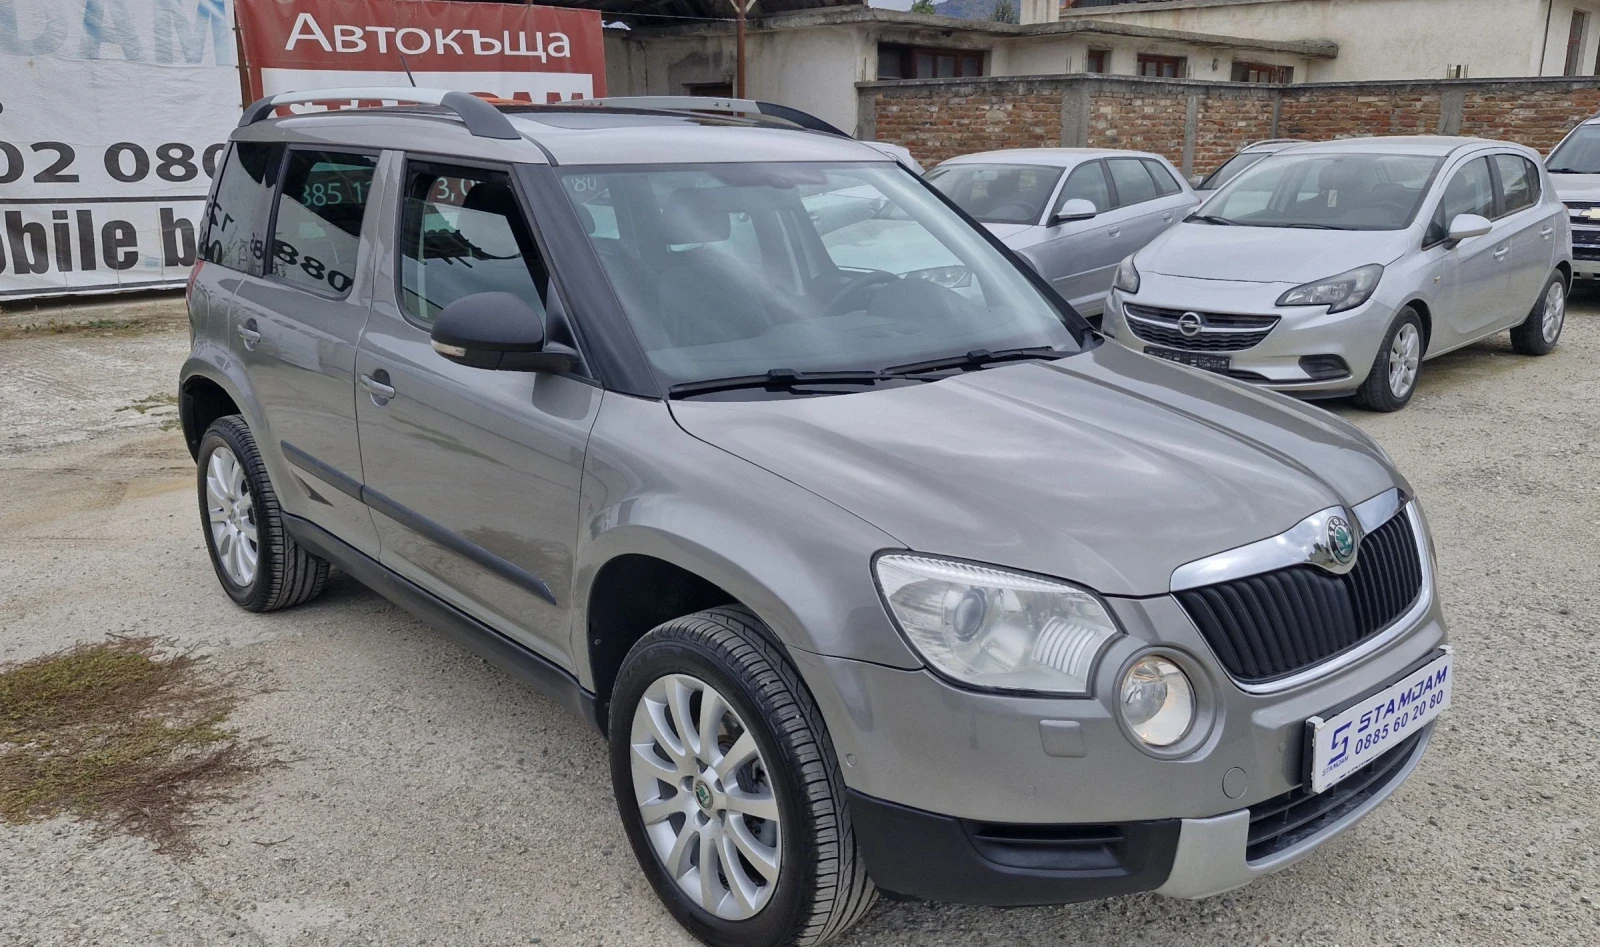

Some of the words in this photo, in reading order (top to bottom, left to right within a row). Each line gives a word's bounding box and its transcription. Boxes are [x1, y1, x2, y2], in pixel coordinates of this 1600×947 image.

[285, 12, 571, 63] Автокъща
[0, 208, 139, 275] bile
[1355, 724, 1389, 755] 0885
[1393, 712, 1409, 732] 60
[1412, 700, 1426, 721] 20
[1429, 689, 1444, 708] 80
